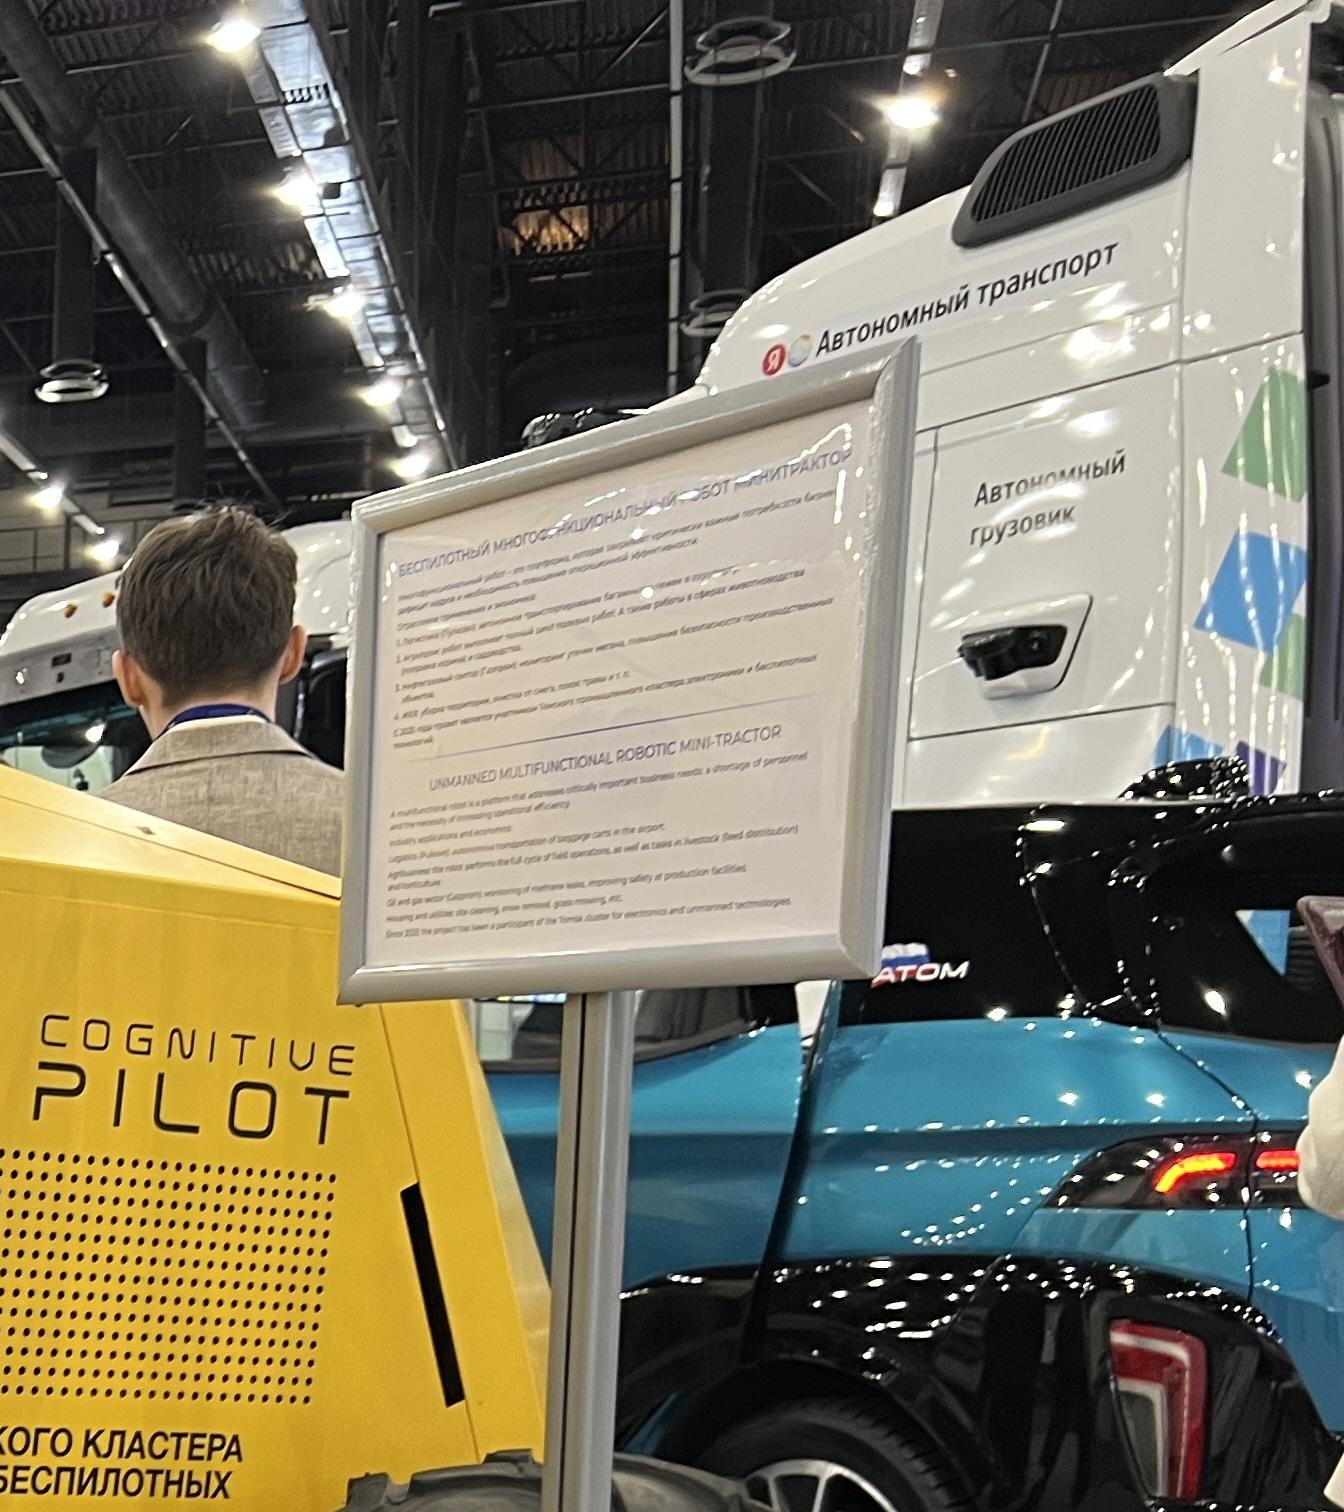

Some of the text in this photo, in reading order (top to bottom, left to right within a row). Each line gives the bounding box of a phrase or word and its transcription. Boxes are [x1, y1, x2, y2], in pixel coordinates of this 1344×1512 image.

[815, 285, 969, 358] Автономный
[977, 242, 1119, 306] транспорт
[974, 448, 1126, 507] Автономный
[398, 539, 490, 576] БЕСПИЛОТНЫЙ
[492, 493, 677, 553] МНОГОФНКЦИОНАЛЬНЫЙ
[679, 478, 731, 504] ОБОТ
[969, 506, 1077, 547] грузовик
[428, 723, 781, 791] UNMANNED MULTIFUNCTIONAL ROBOTIC MINI-TRACTOR
[871, 961, 970, 988] ATOM
[40, 1014, 355, 1076] COGNITIVE
[33, 1061, 350, 1145] PILOT
[81, 1428, 244, 1462] КЛАСТЕРА
